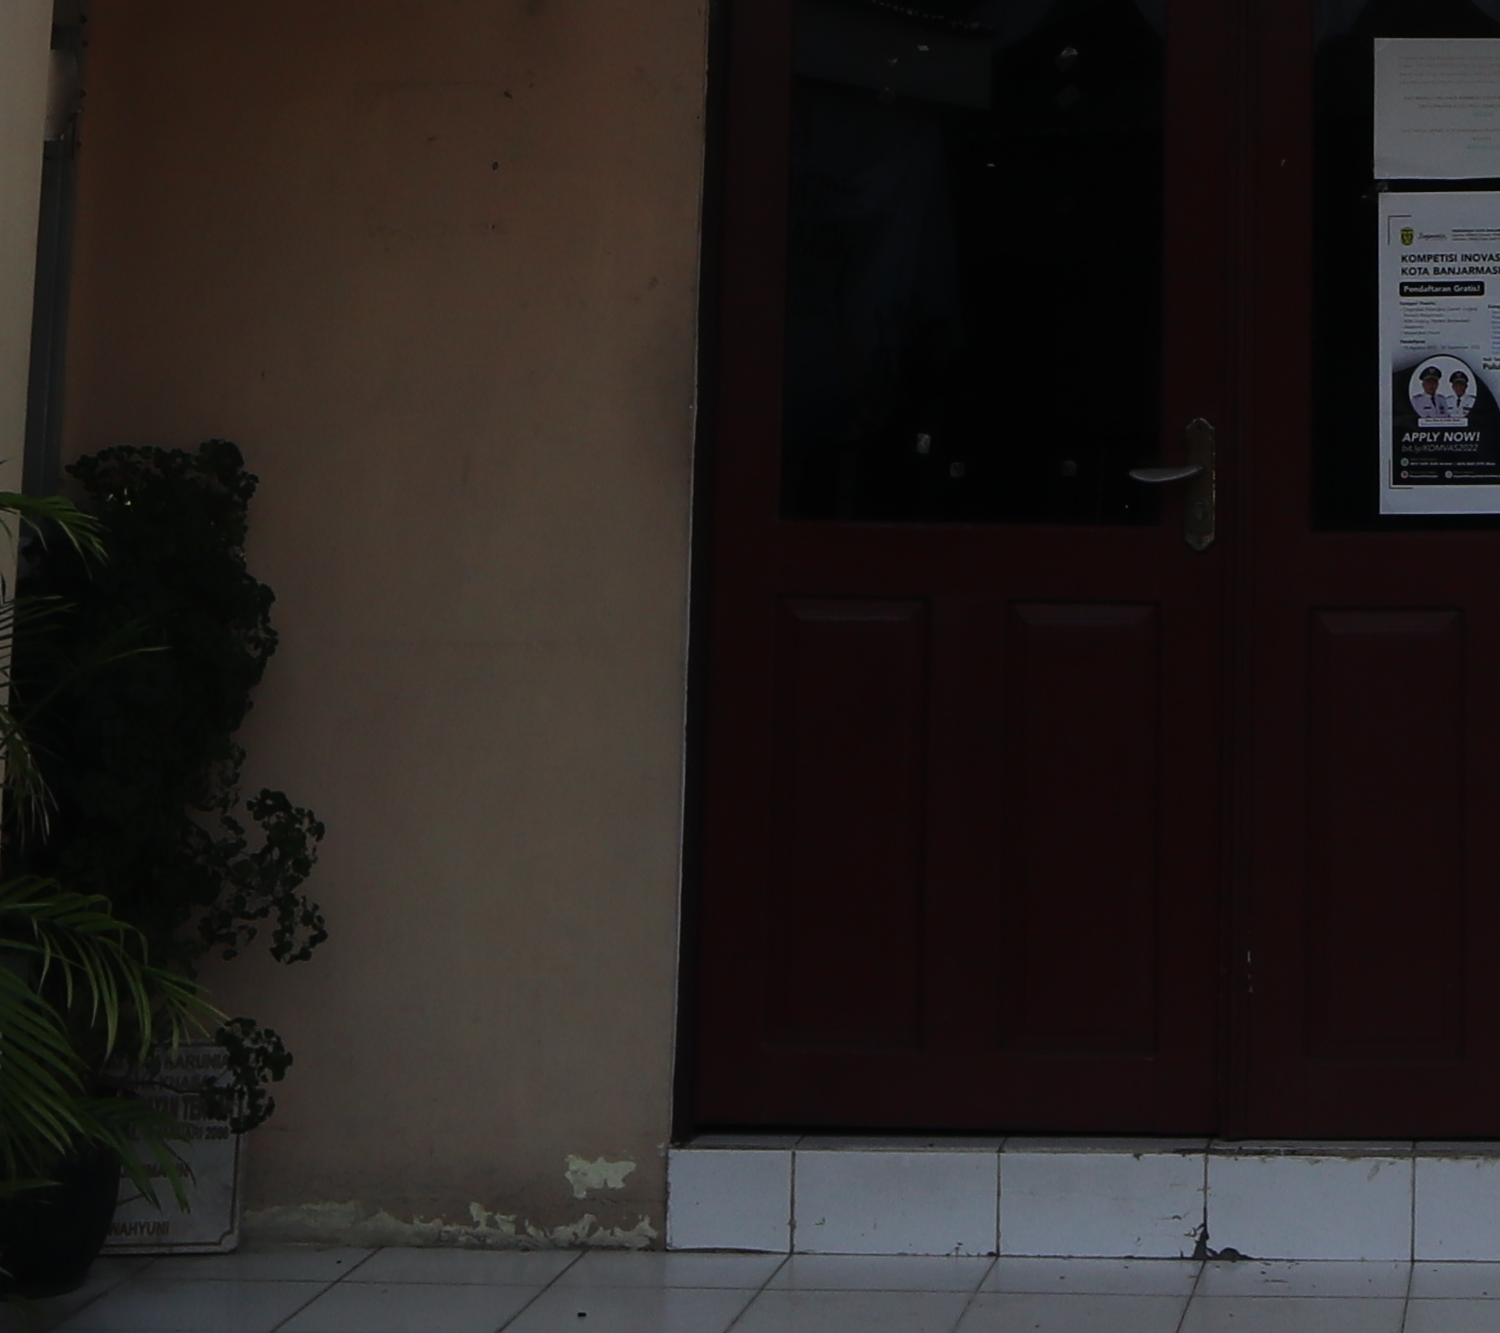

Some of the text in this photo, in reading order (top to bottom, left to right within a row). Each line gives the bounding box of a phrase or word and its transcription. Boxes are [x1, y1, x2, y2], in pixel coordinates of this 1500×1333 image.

[1400, 253, 1457, 263] KOMPETISI
[1400, 266, 1430, 276] KOTA
[1403, 285, 1451, 293] Pendaftaran
[1402, 431, 1480, 442] APPLY NOW!
